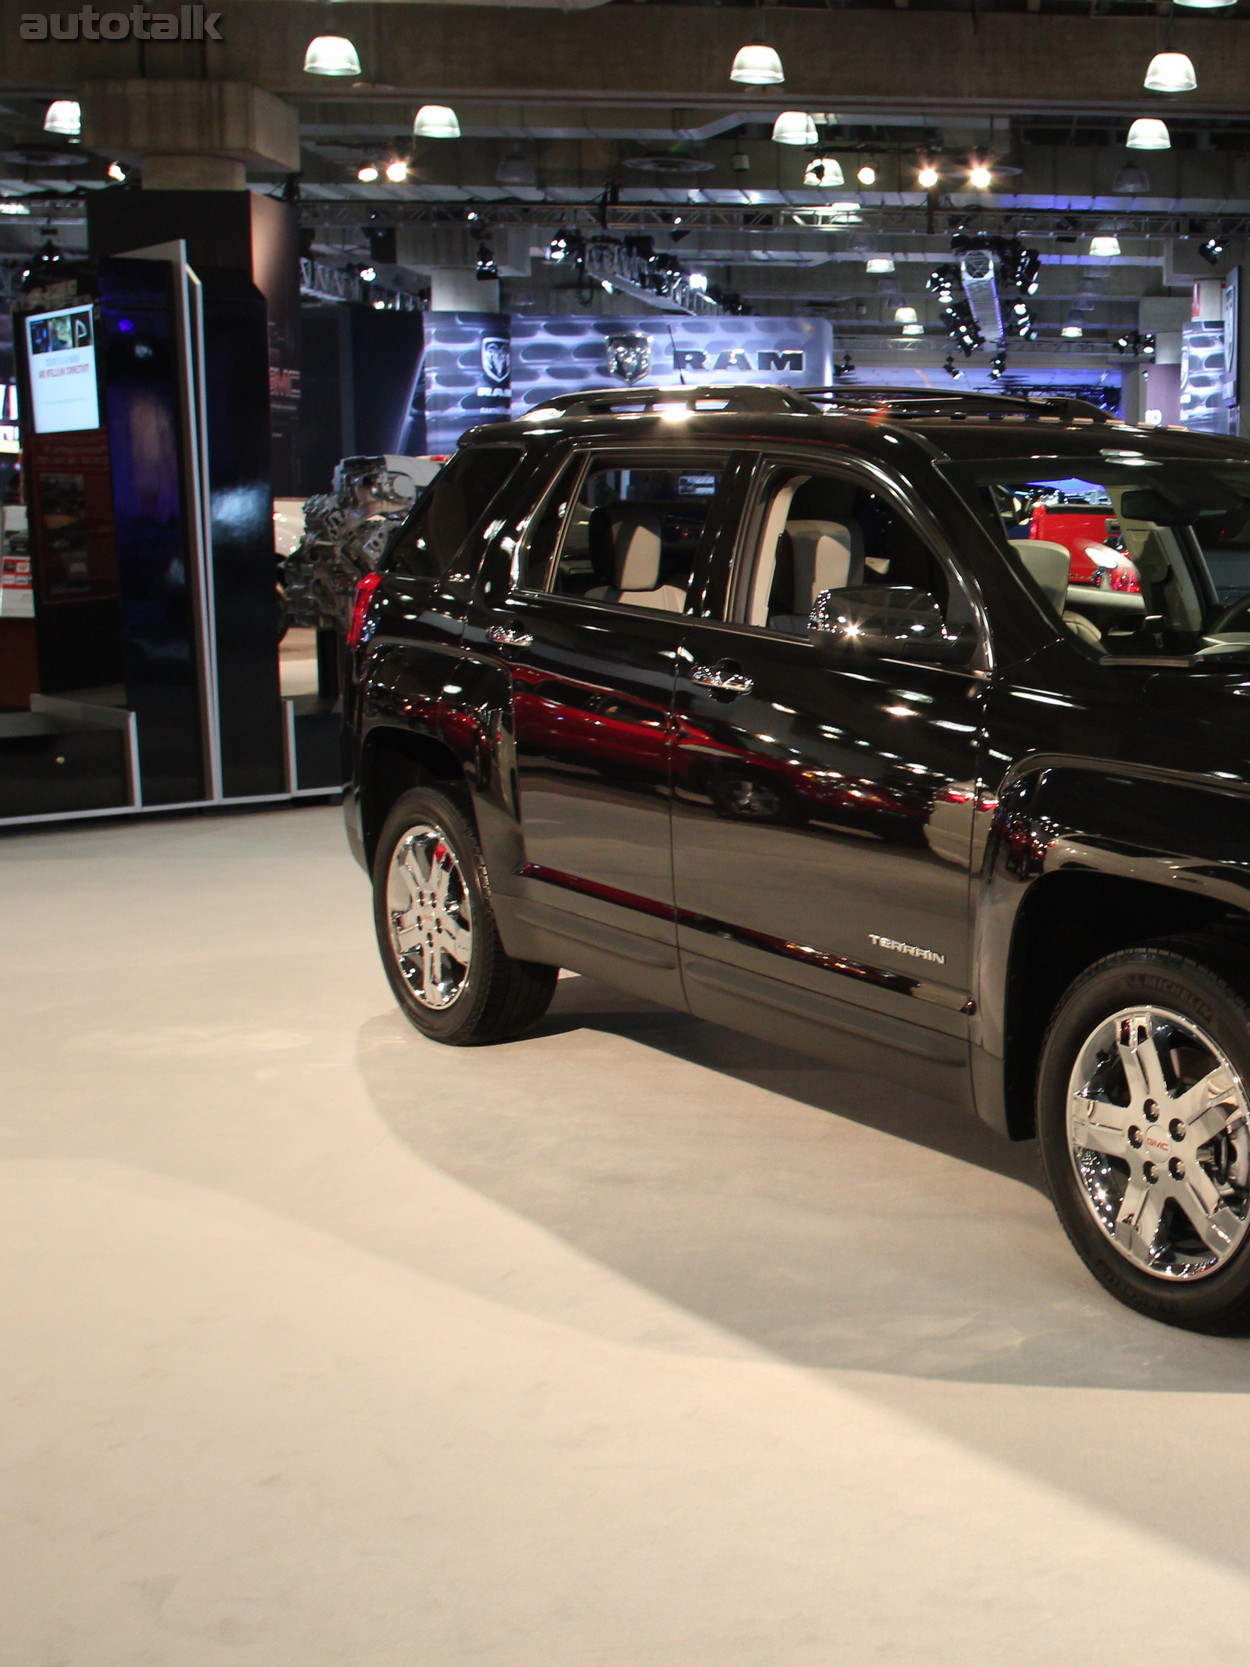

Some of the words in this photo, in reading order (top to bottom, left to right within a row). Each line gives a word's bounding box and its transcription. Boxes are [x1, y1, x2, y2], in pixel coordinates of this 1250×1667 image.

[674, 350, 804, 371] RAM
[868, 933, 946, 965] TERRAIN
[1143, 975, 1214, 1024] MICHELIN
[1146, 1137, 1169, 1151] GMC
